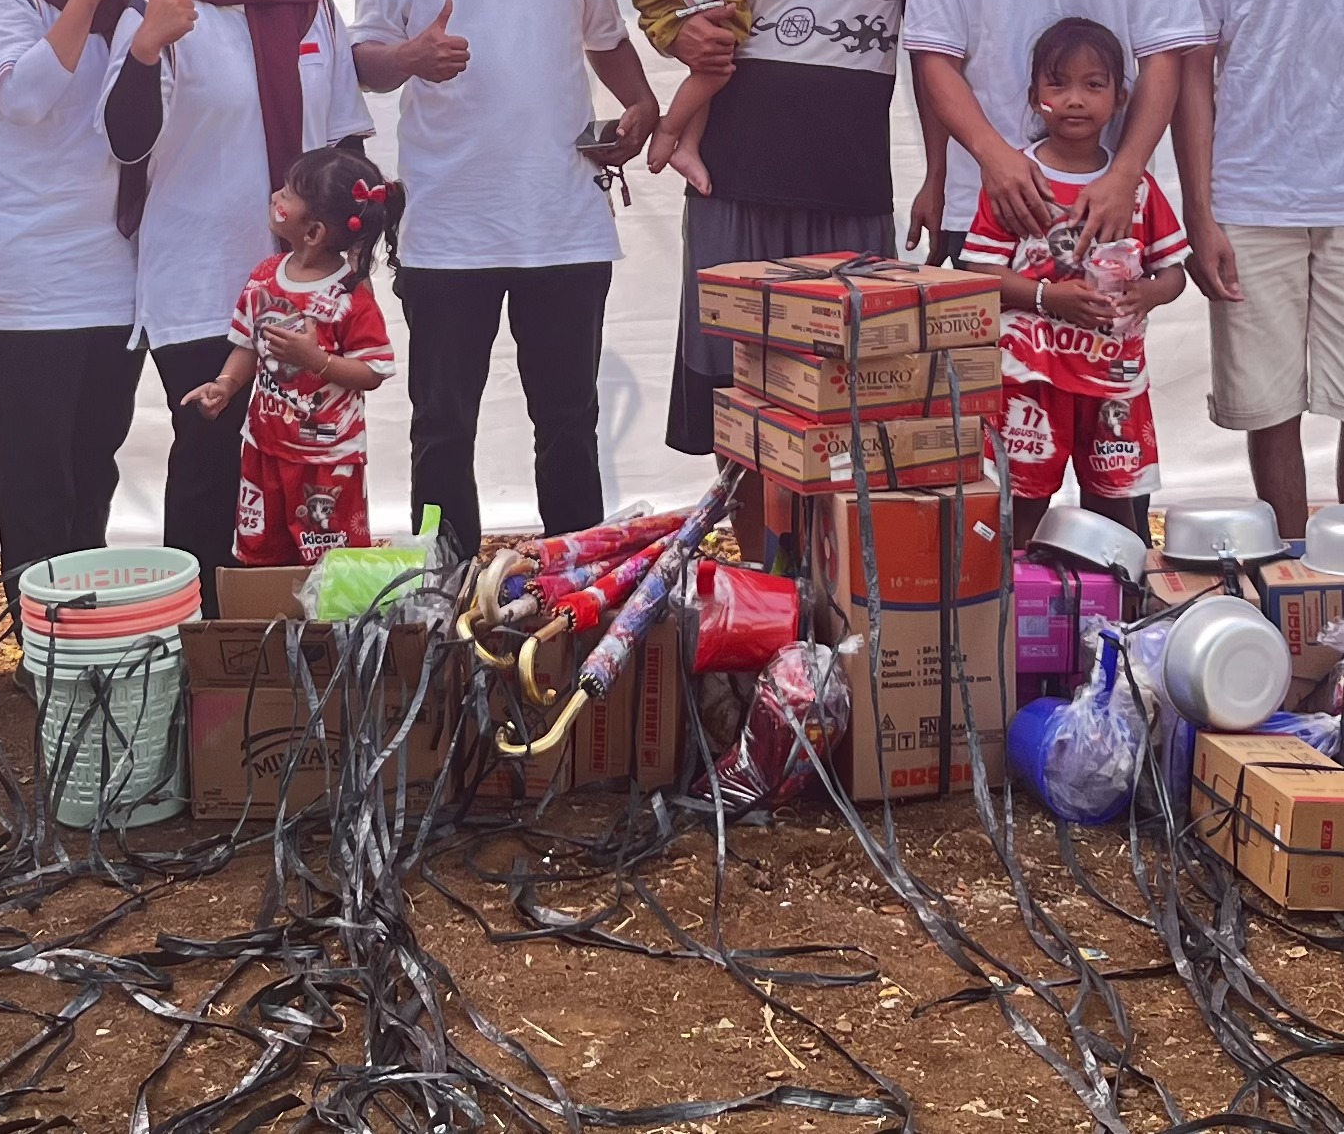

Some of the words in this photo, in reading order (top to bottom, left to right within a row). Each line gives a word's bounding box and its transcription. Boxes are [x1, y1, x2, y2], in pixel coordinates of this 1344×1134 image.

[1022, 405, 1044, 428] 17
[1008, 427, 1047, 441] AGUSTUS
[1007, 439, 1044, 455] 1945
[1096, 441, 1134, 455] kicau
[242, 486, 261, 506] 17
[302, 533, 341, 546] kicau
[881, 649, 899, 658] Type
[881, 659, 897, 668] Volt
[881, 681, 915, 689] Measure
